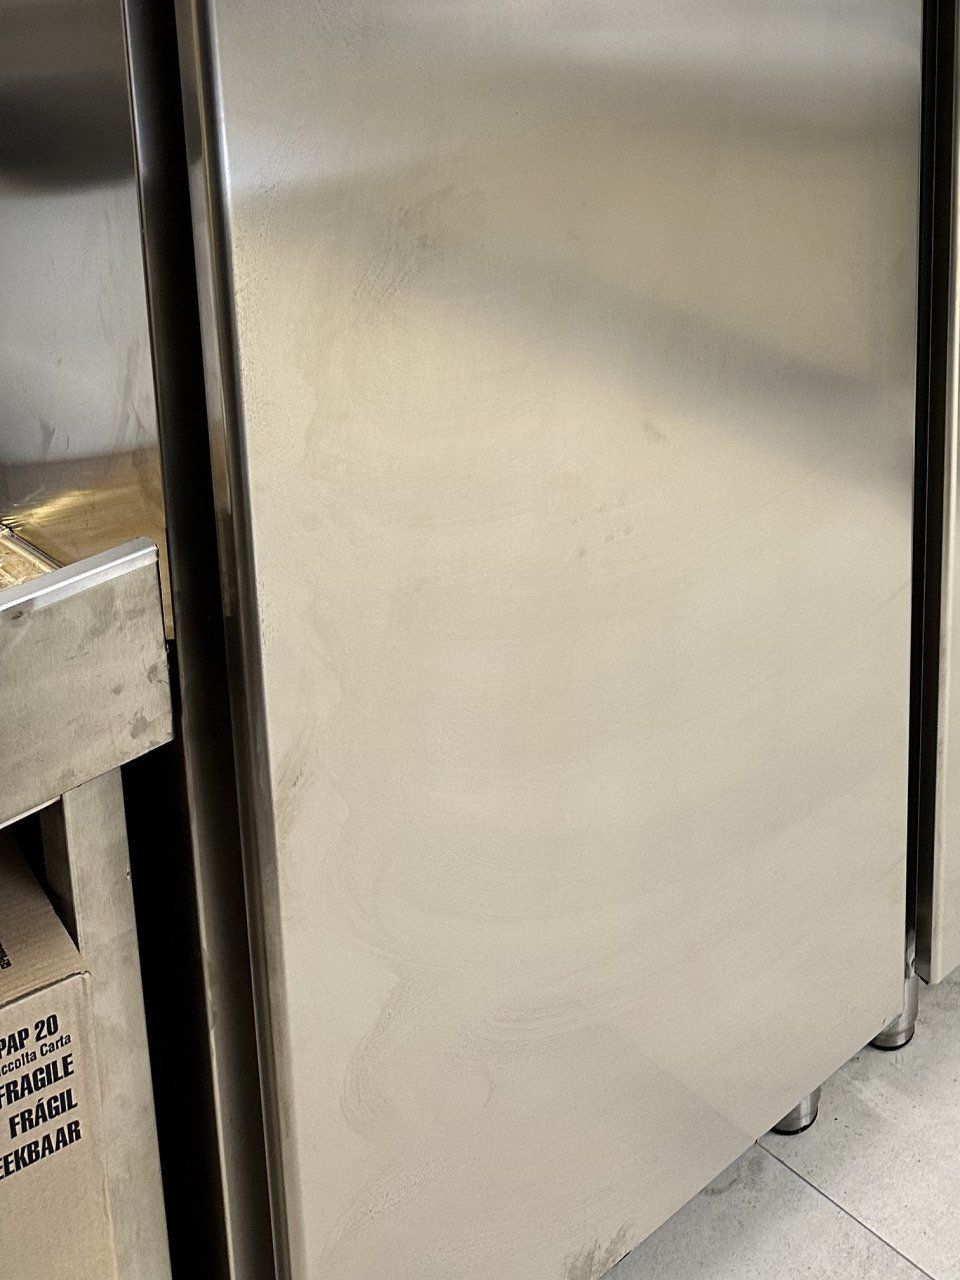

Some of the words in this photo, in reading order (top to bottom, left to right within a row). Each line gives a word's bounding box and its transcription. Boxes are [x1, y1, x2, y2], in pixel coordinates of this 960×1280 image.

[34, 1013, 59, 1042] 20
[40, 1034, 72, 1057] Carta
[8, 1088, 78, 1140] FRÁGIL
